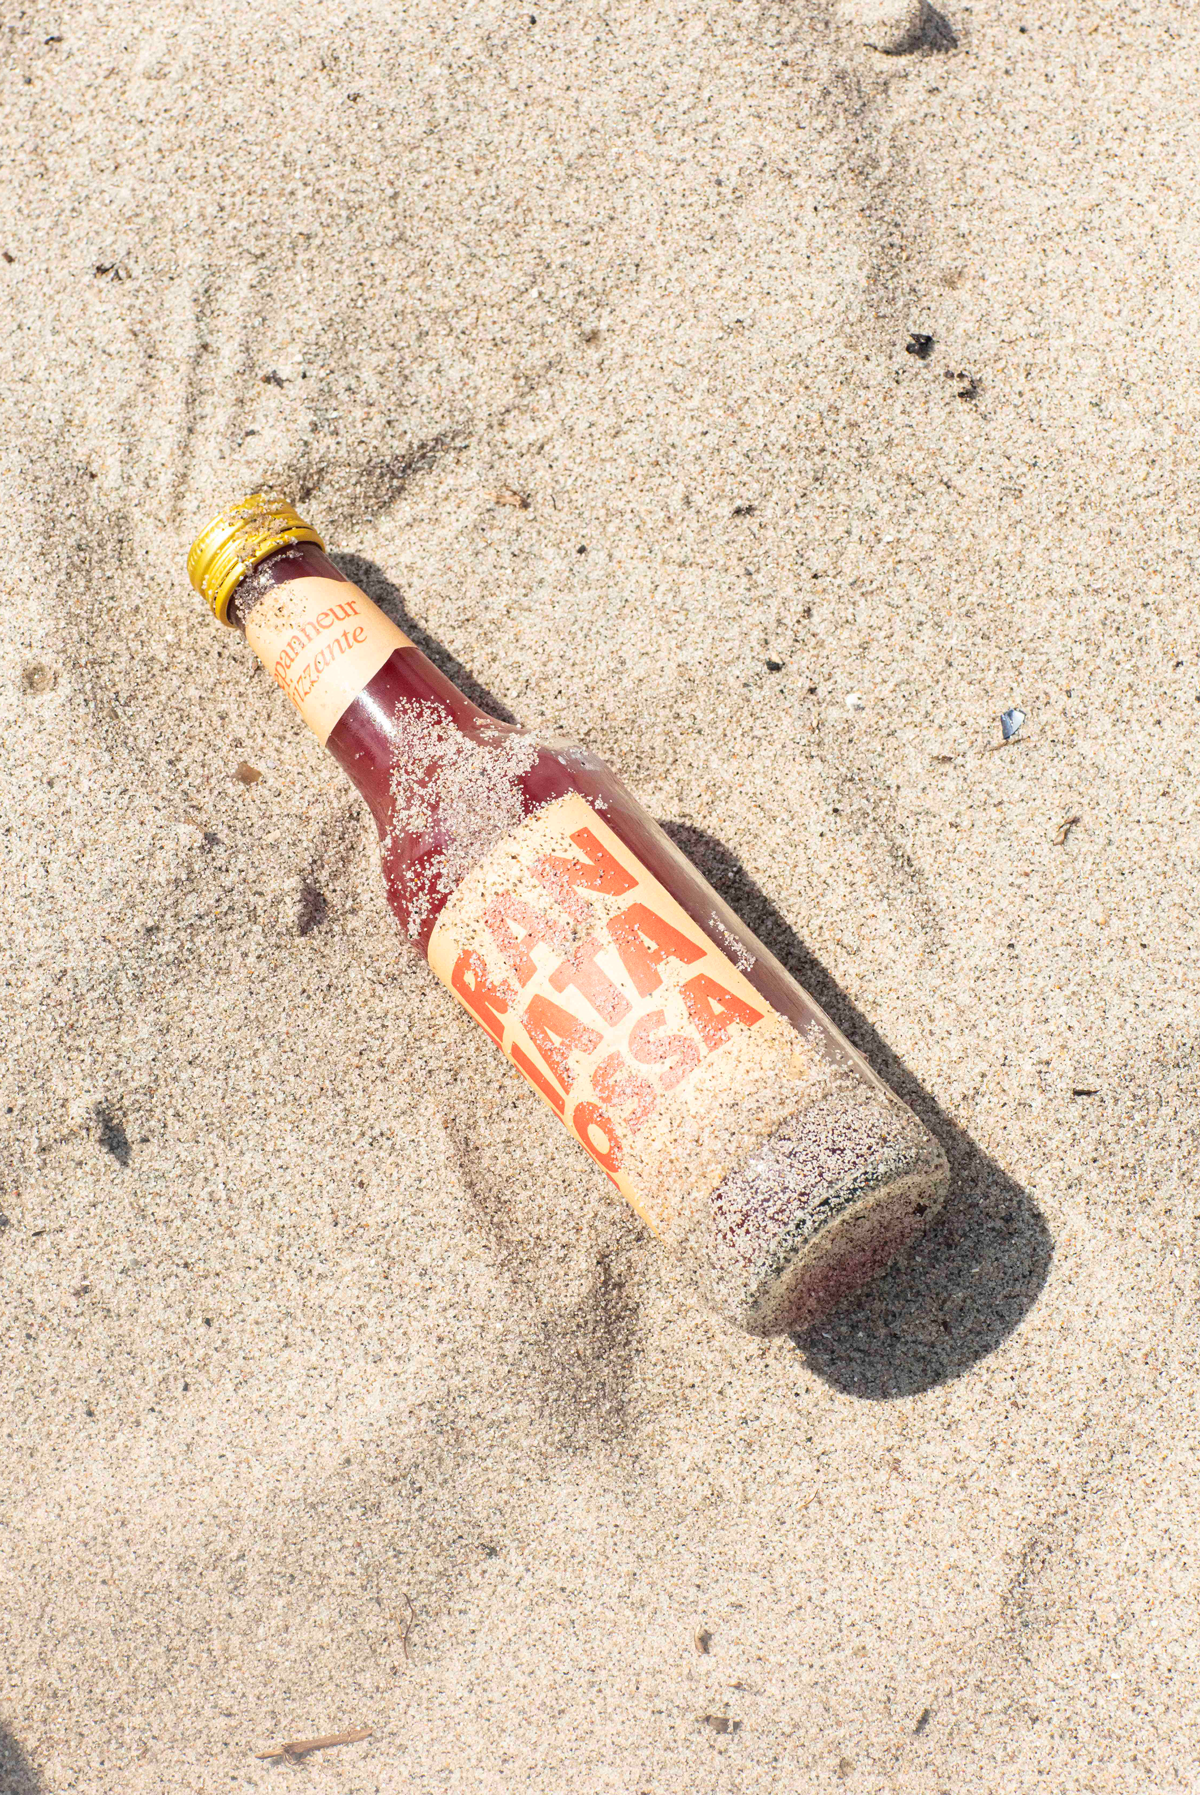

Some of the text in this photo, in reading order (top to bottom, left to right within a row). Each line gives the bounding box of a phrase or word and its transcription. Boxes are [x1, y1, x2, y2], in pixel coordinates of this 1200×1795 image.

[451, 826, 639, 1051] RAN
[511, 902, 708, 1122] IATA
[573, 972, 765, 1191] OSSA
